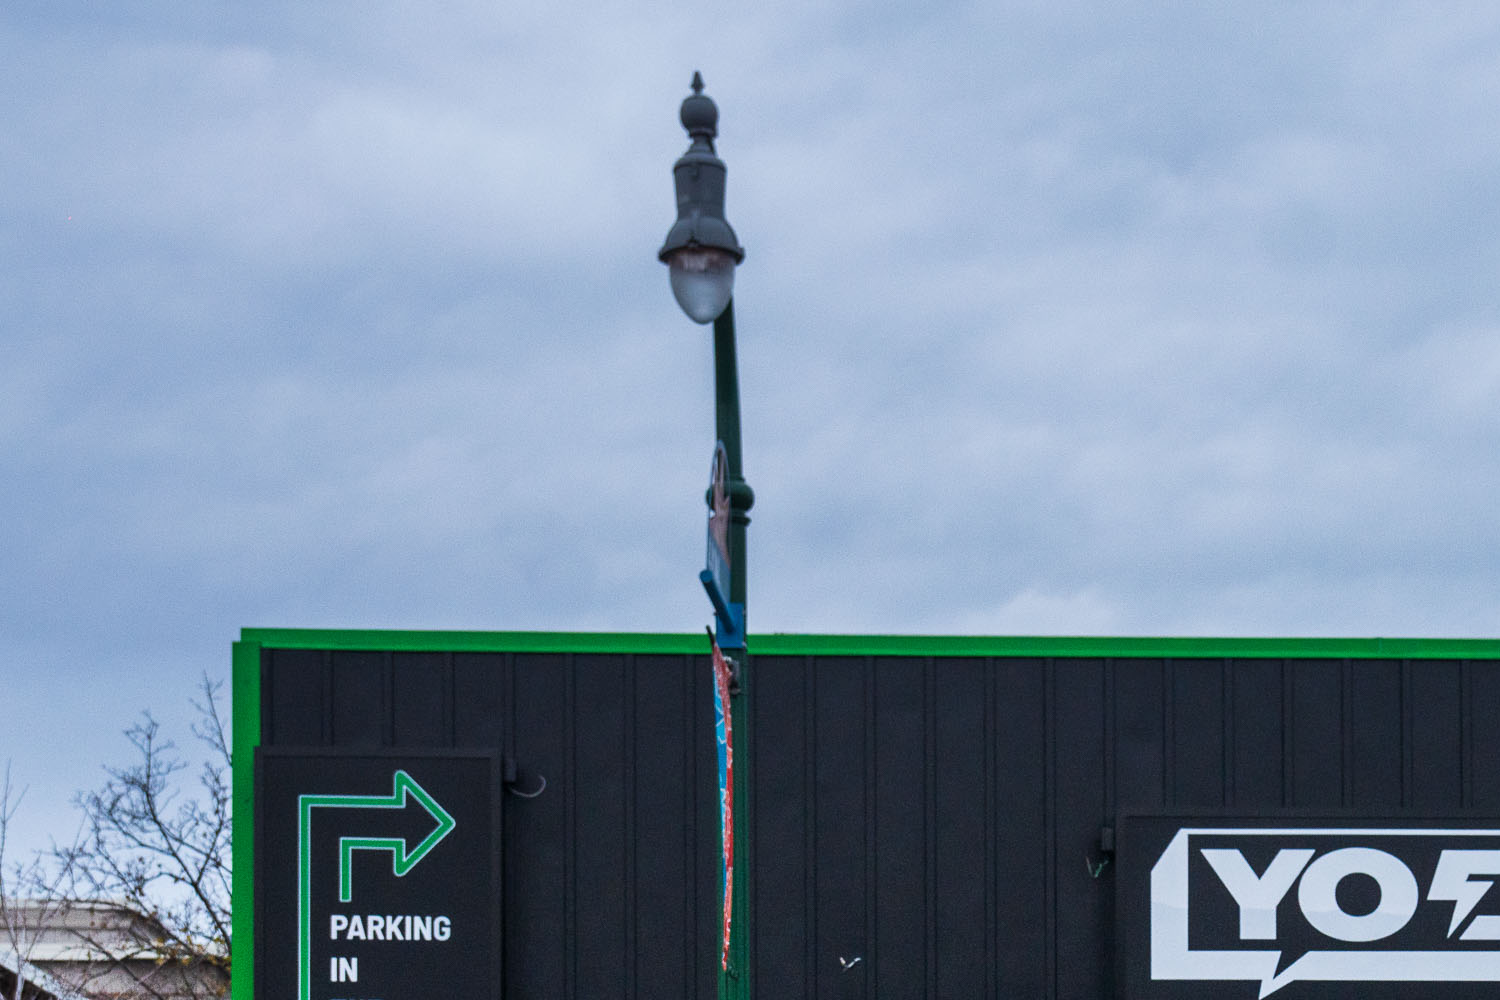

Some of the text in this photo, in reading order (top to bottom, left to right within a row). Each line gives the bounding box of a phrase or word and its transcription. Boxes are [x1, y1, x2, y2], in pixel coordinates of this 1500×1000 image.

[1201, 847, 1419, 943] YO
[330, 914, 451, 942] PARKING
[330, 957, 358, 983] IN
